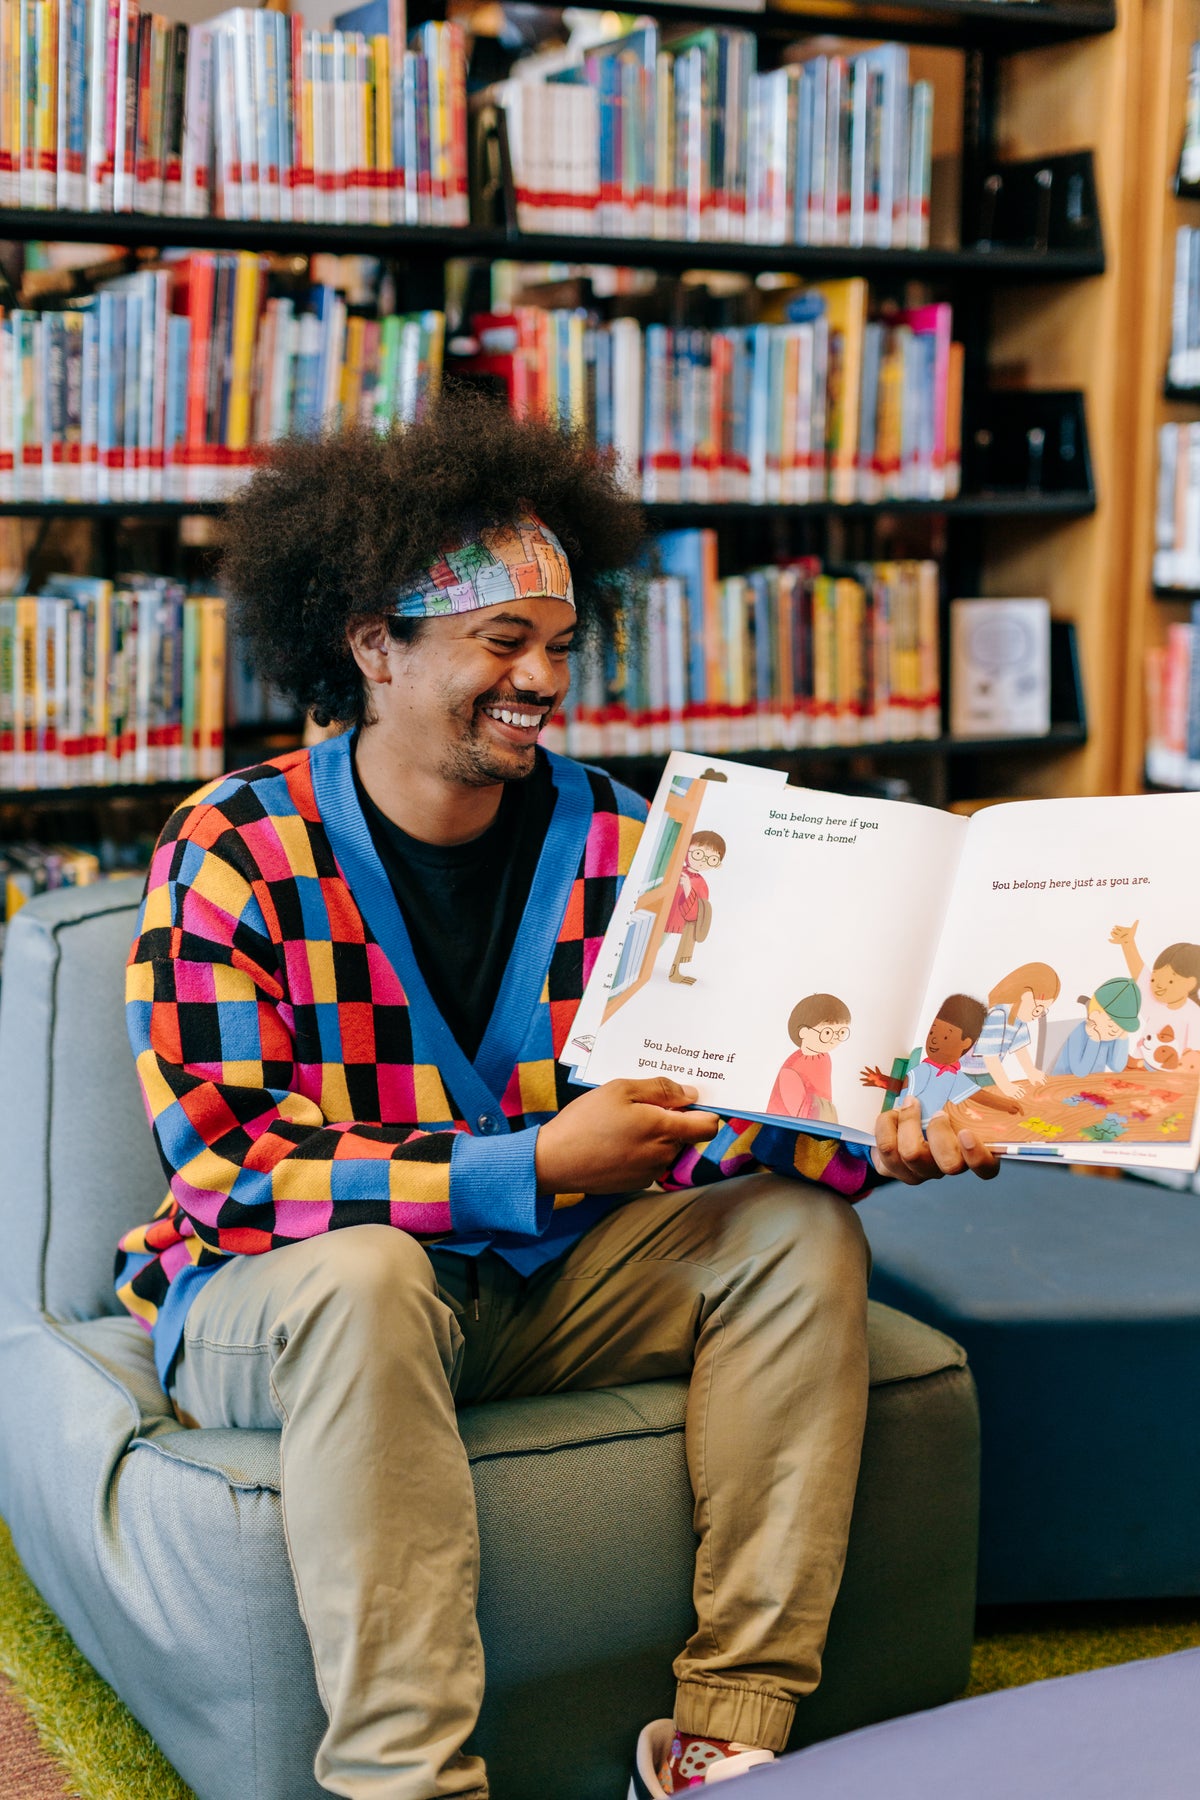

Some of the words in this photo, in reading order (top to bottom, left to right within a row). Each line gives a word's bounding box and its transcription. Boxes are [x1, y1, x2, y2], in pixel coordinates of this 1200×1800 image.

[769, 809, 787, 820] You
[790, 812, 824, 825] belong
[825, 816, 847, 827] here
[849, 818, 858, 828] if
[859, 820, 879, 830] you
[764, 827, 790, 838] don't
[791, 830, 816, 840] have
[826, 833, 857, 845] home!
[992, 880, 1010, 890] You
[1012, 879, 1047, 890] belong
[1049, 878, 1071, 889] here
[1072, 877, 1094, 890] just
[1096, 878, 1107, 887] as
[1110, 877, 1129, 888] you
[1132, 876, 1151, 885] are.
[643, 1038, 663, 1051] You
[664, 1043, 700, 1059] belong
[702, 1049, 725, 1061] here
[726, 1052, 736, 1063] if
[638, 1057, 658, 1068] you
[659, 1060, 685, 1074] have
[687, 1067, 693, 1075] a
